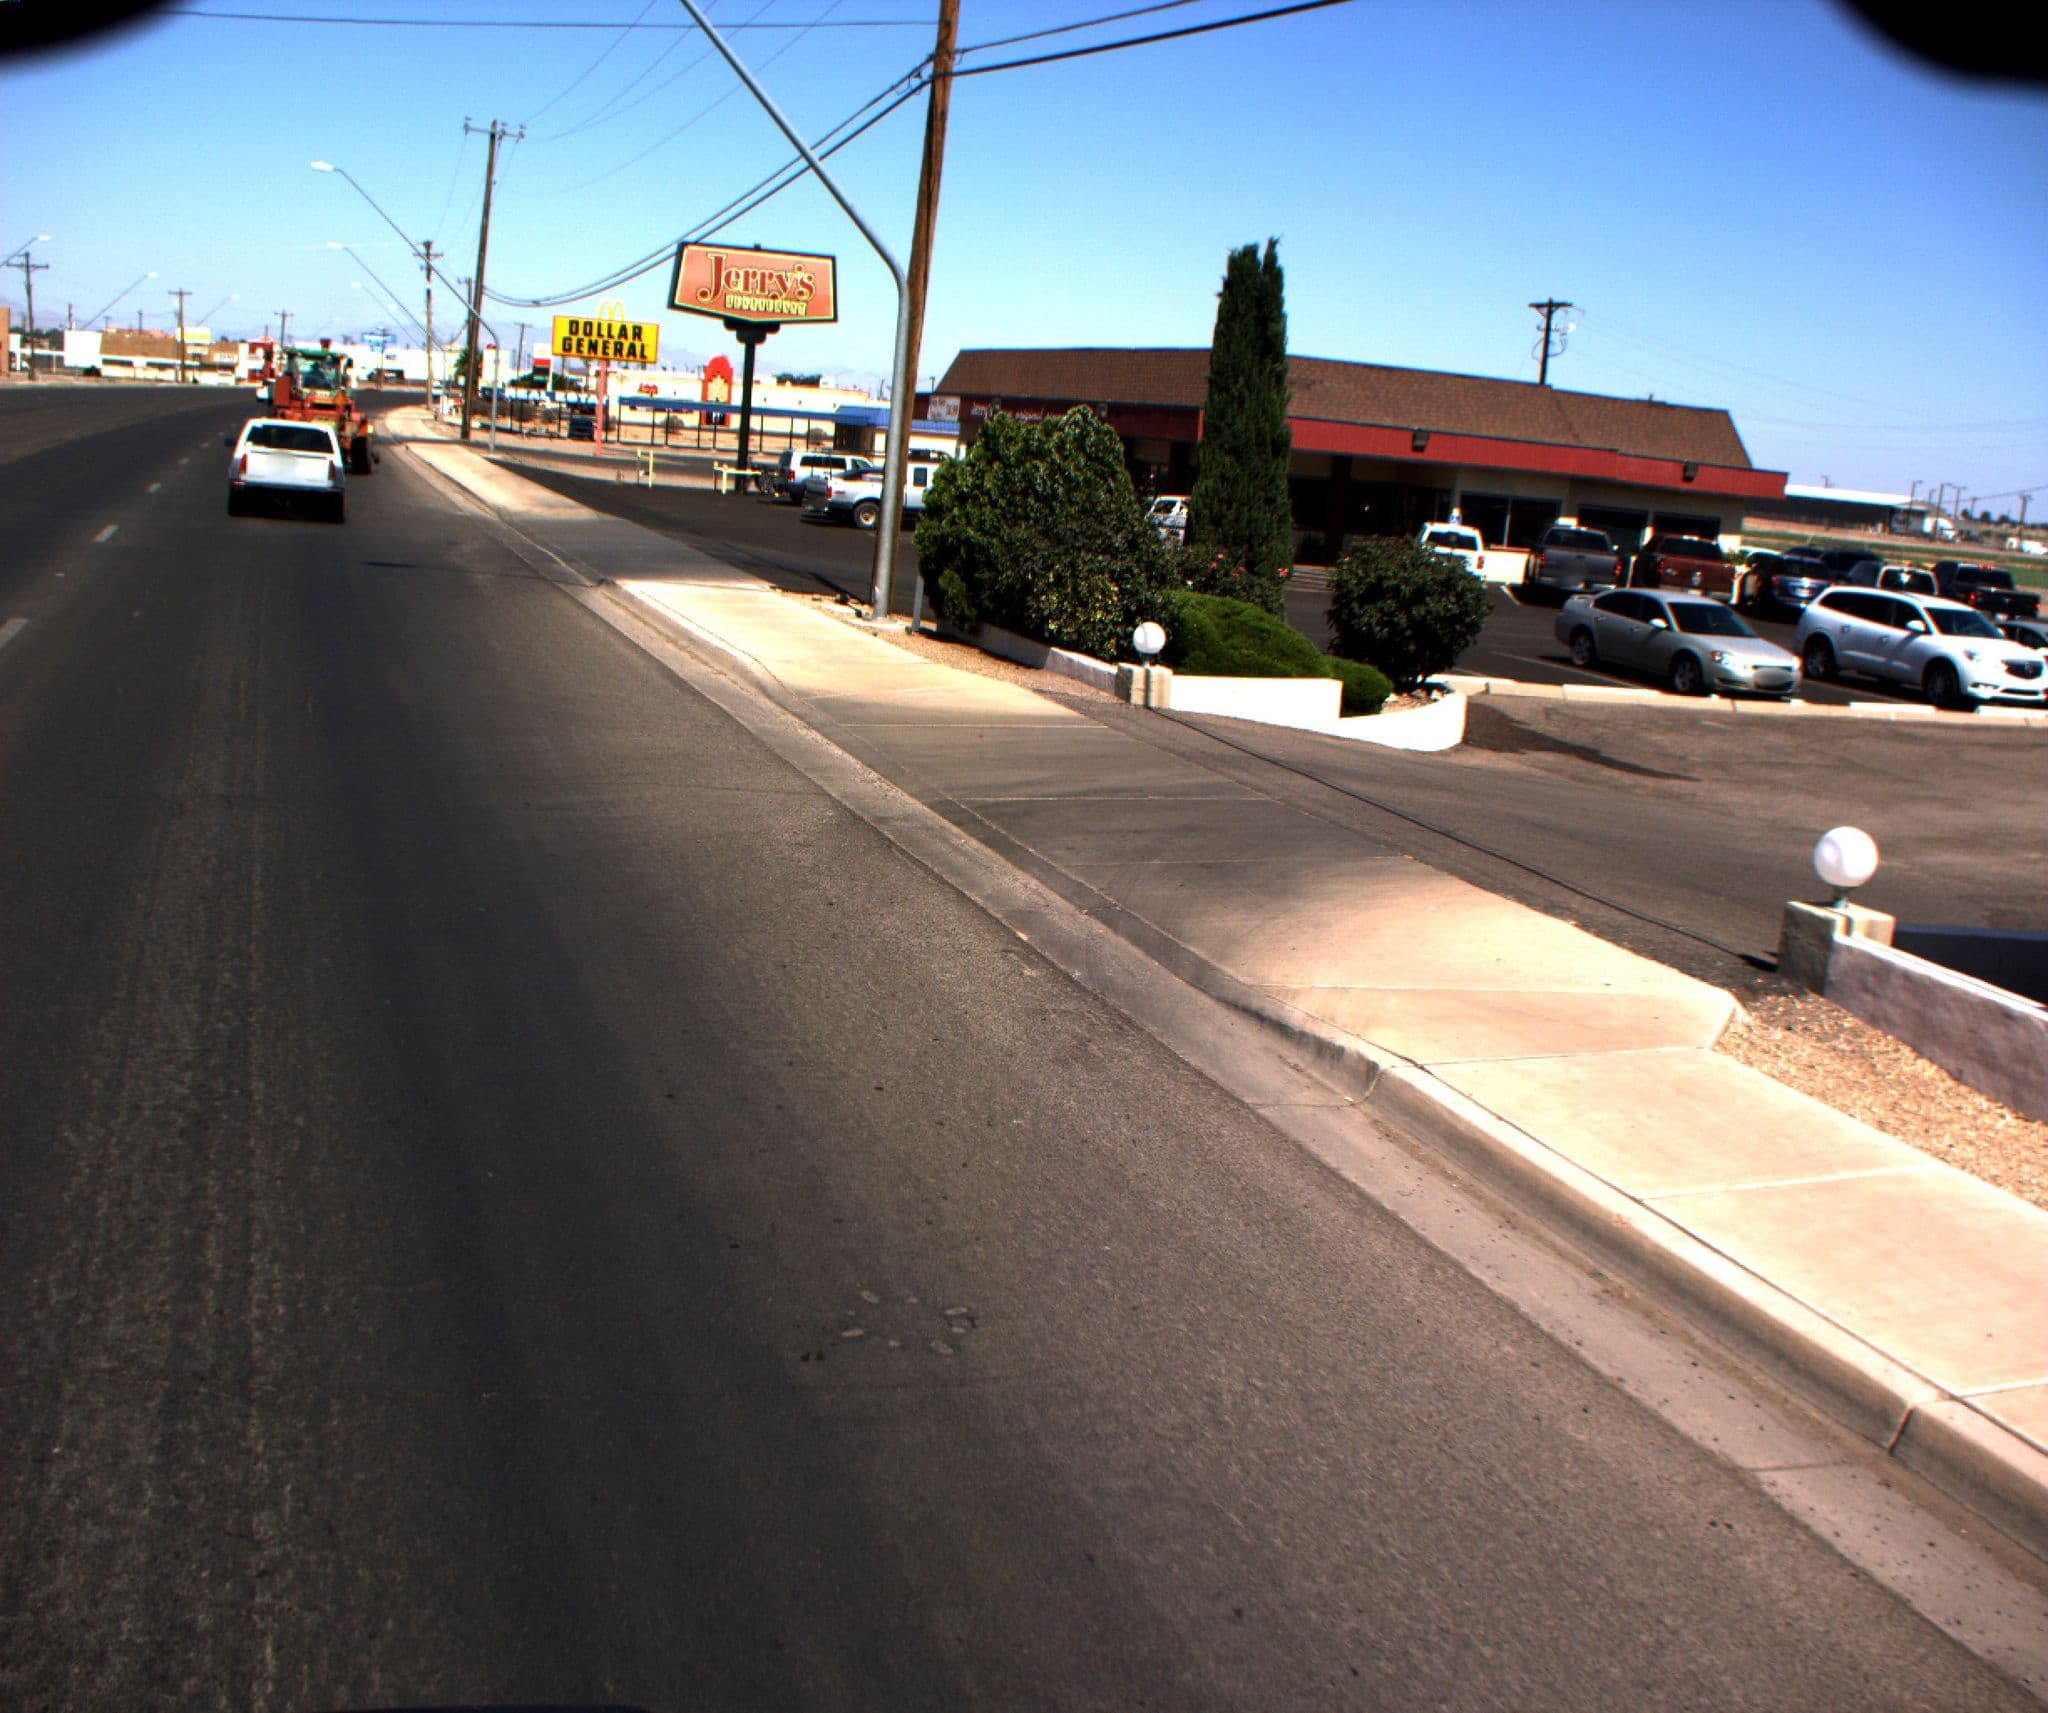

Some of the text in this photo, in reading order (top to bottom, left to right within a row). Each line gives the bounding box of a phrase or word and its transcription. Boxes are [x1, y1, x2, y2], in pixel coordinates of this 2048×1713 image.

[694, 251, 816, 303] Jerry's
[568, 319, 643, 341] DOLLAR
[562, 336, 647, 360] GENERAL
